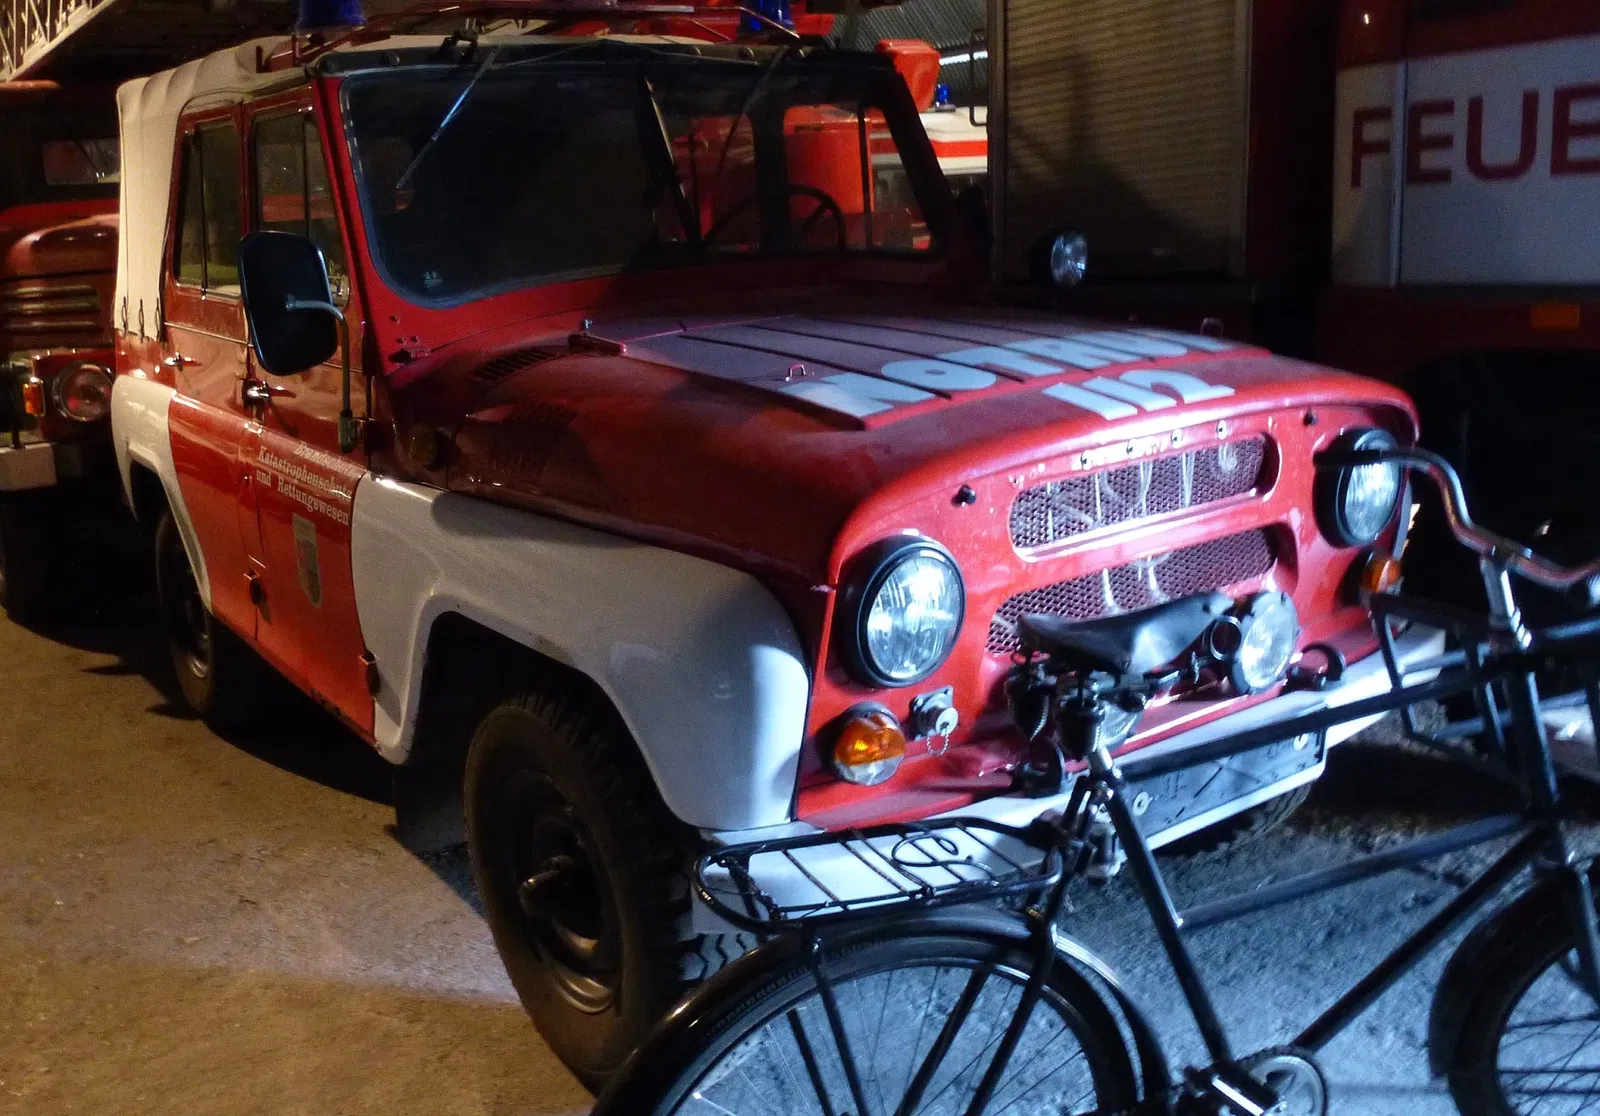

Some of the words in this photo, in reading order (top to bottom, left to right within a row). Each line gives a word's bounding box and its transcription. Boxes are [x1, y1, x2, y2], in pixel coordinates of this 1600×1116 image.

[1352, 83, 1600, 187] FEUE
[778, 328, 1235, 418] NOTRUF
[1043, 370, 1236, 421] 112
[256, 469, 273, 488] und
[276, 476, 350, 526] Rettungswesen
[258, 446, 352, 501] Katastrophenschutz
